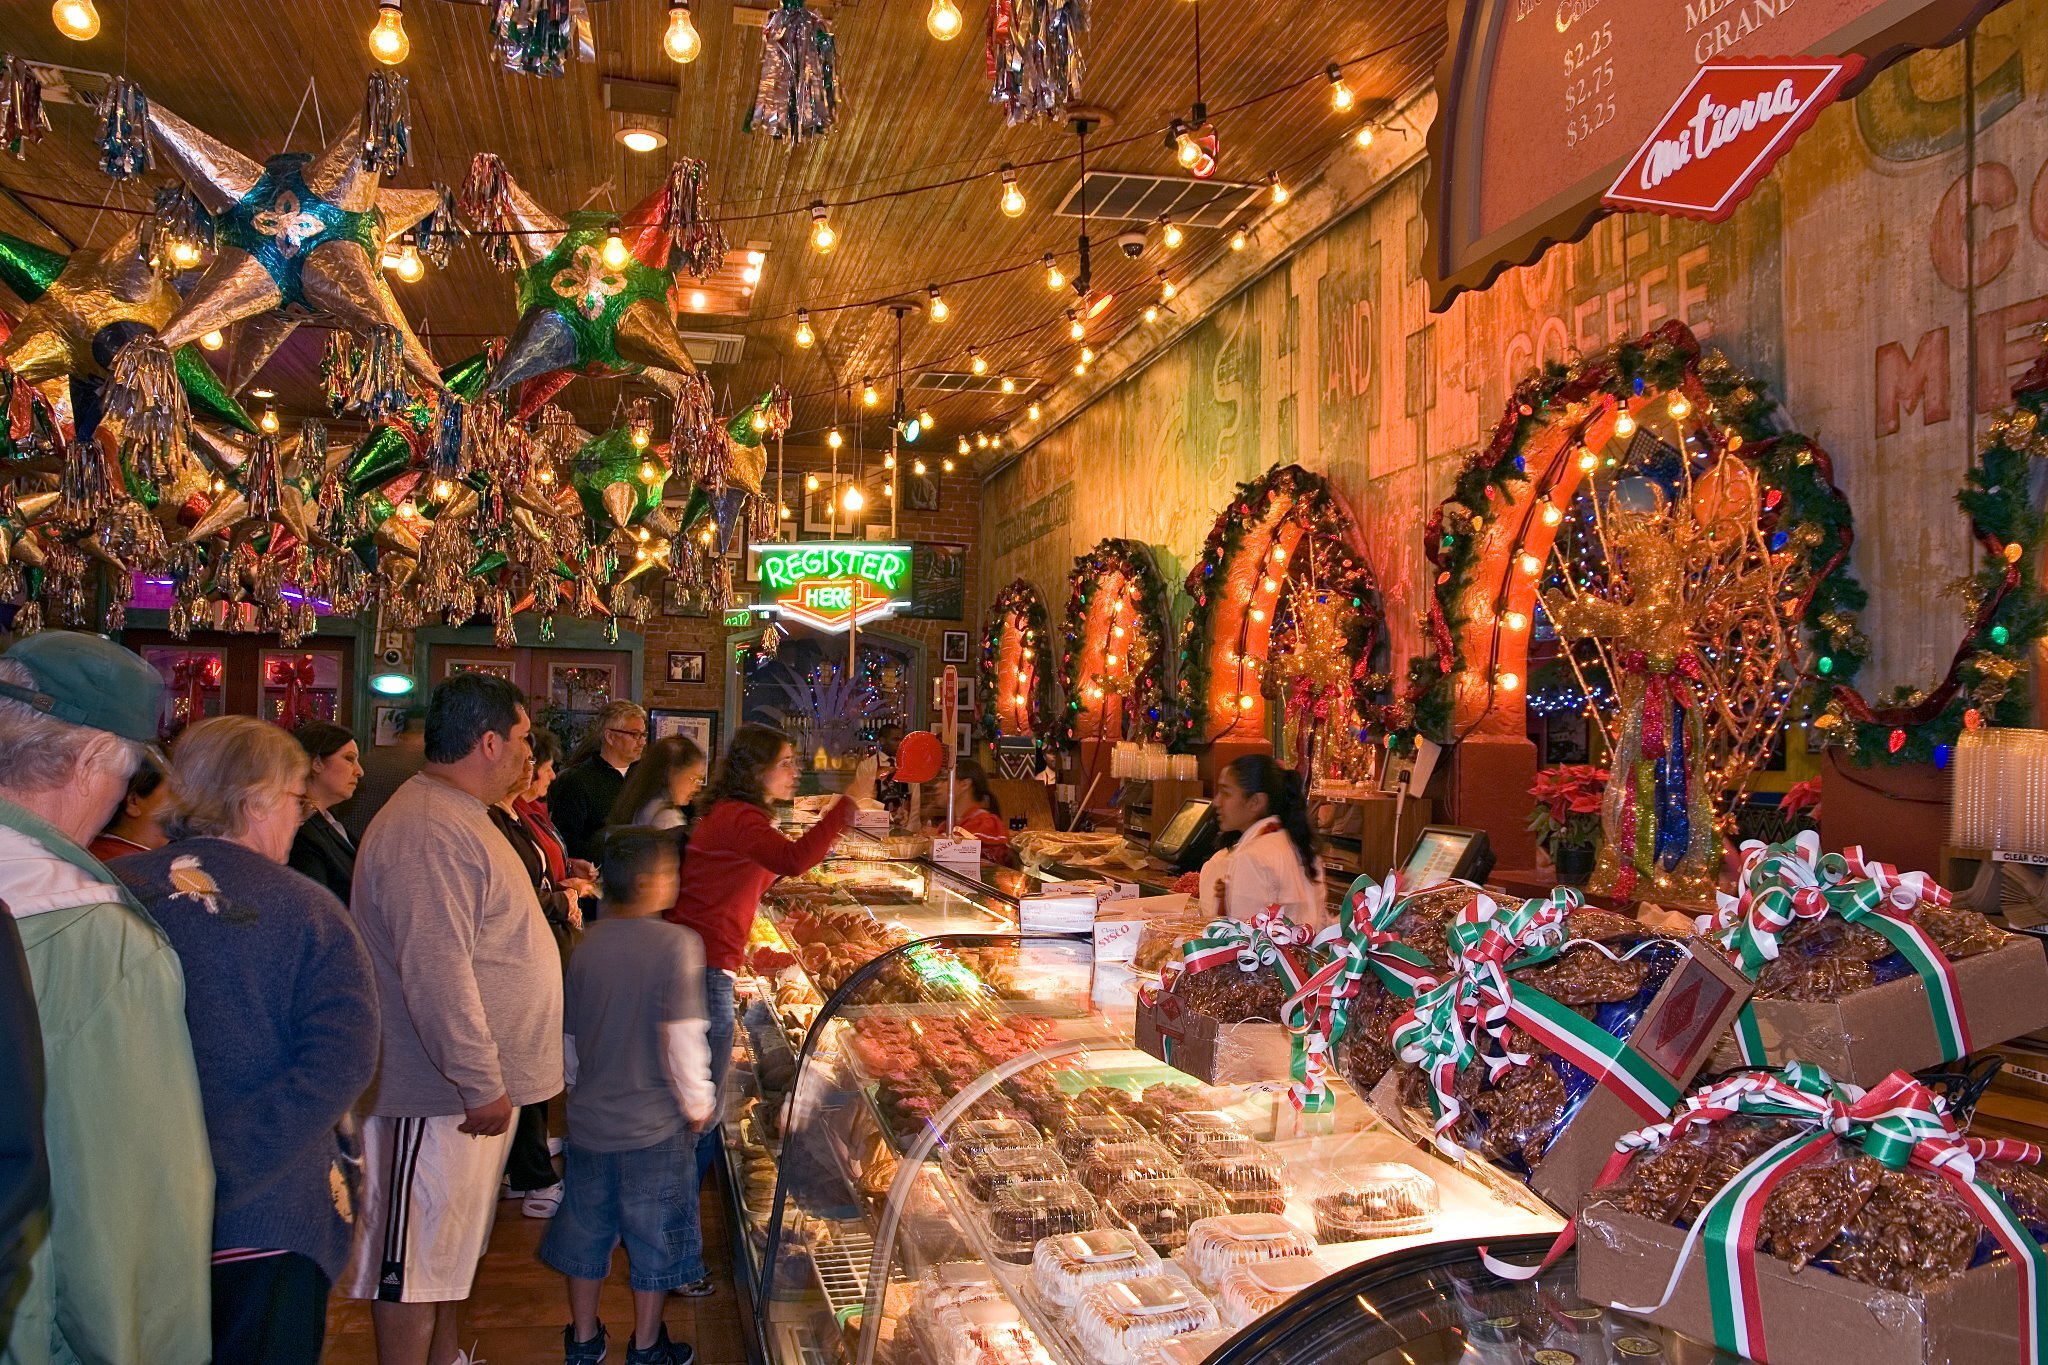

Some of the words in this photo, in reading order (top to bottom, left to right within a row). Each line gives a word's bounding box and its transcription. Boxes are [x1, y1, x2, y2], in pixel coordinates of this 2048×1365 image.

[1564, 19, 1613, 78] $2.25
[1565, 56, 1614, 113] $2.75
[1567, 91, 1617, 149] $3.25
[1328, 300, 1373, 406] AND
[765, 549, 900, 590] REGISTER
[805, 586, 858, 609] HERE
[2004, 853, 2029, 862] CLEAR
[1098, 924, 1130, 948] SYSCO
[2011, 1065, 2039, 1080] LARGE
